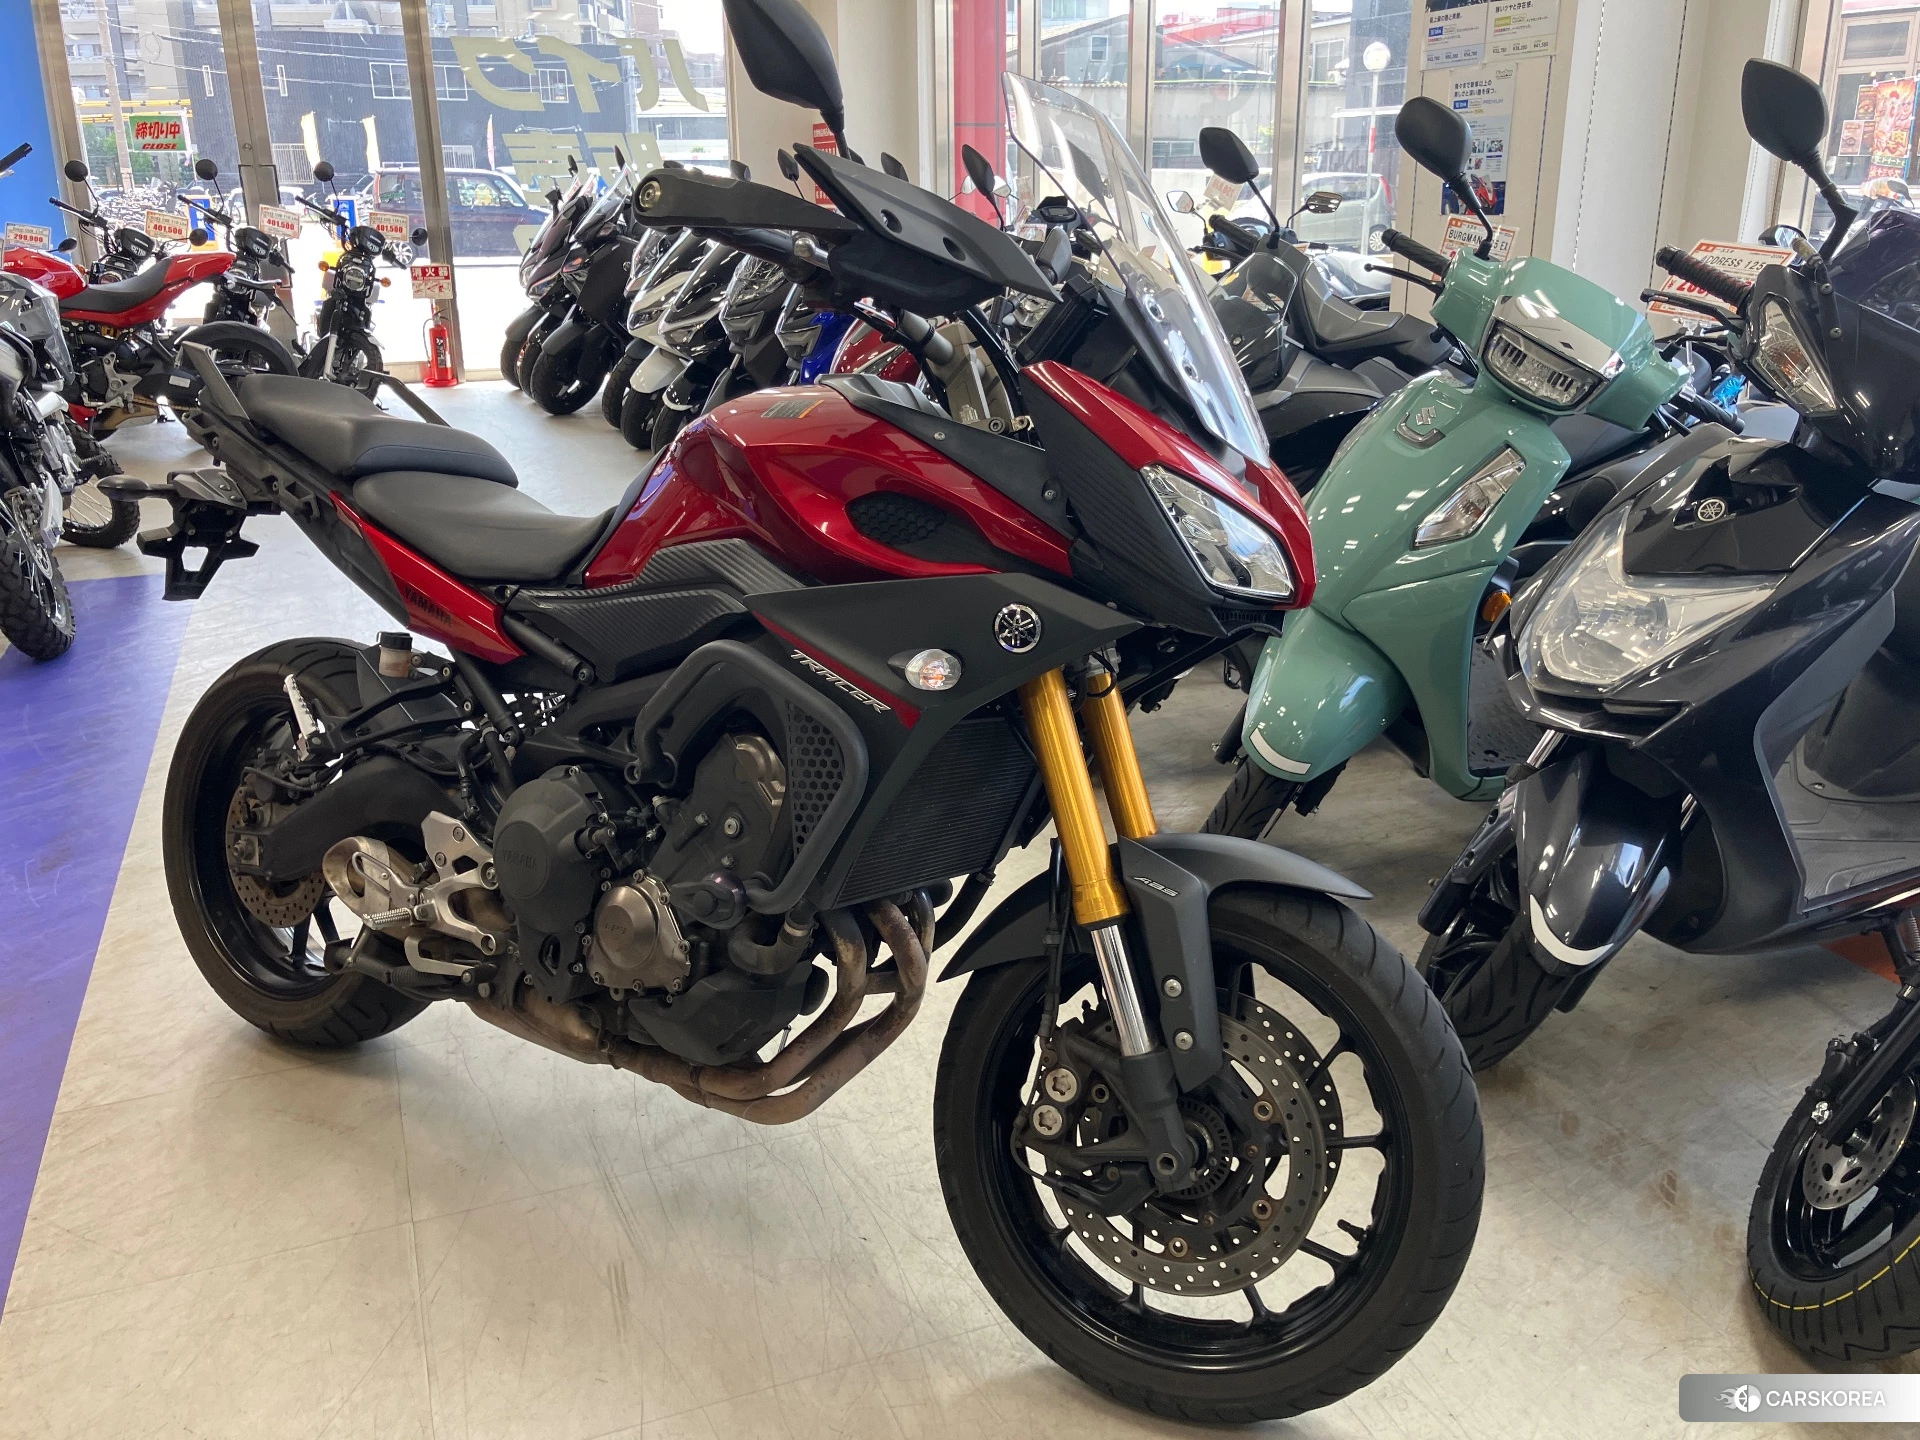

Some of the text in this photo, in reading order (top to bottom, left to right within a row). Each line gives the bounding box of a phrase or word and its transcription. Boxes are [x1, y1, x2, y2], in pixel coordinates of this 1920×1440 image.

[141, 142, 178, 150] CLOSE
[152, 223, 183, 235] 401,500
[376, 224, 403, 234] 401,500
[13, 233, 44, 243] 299,900
[1448, 229, 1483, 245] BURGMAN
[1499, 242, 1509, 251] EX
[1700, 254, 1767, 271] ADDRESS 125
[411, 267, 449, 278] 消火器
[404, 584, 453, 627] YAMAHA
[790, 648, 892, 714] TRACER
[1132, 875, 1180, 898] ABS
